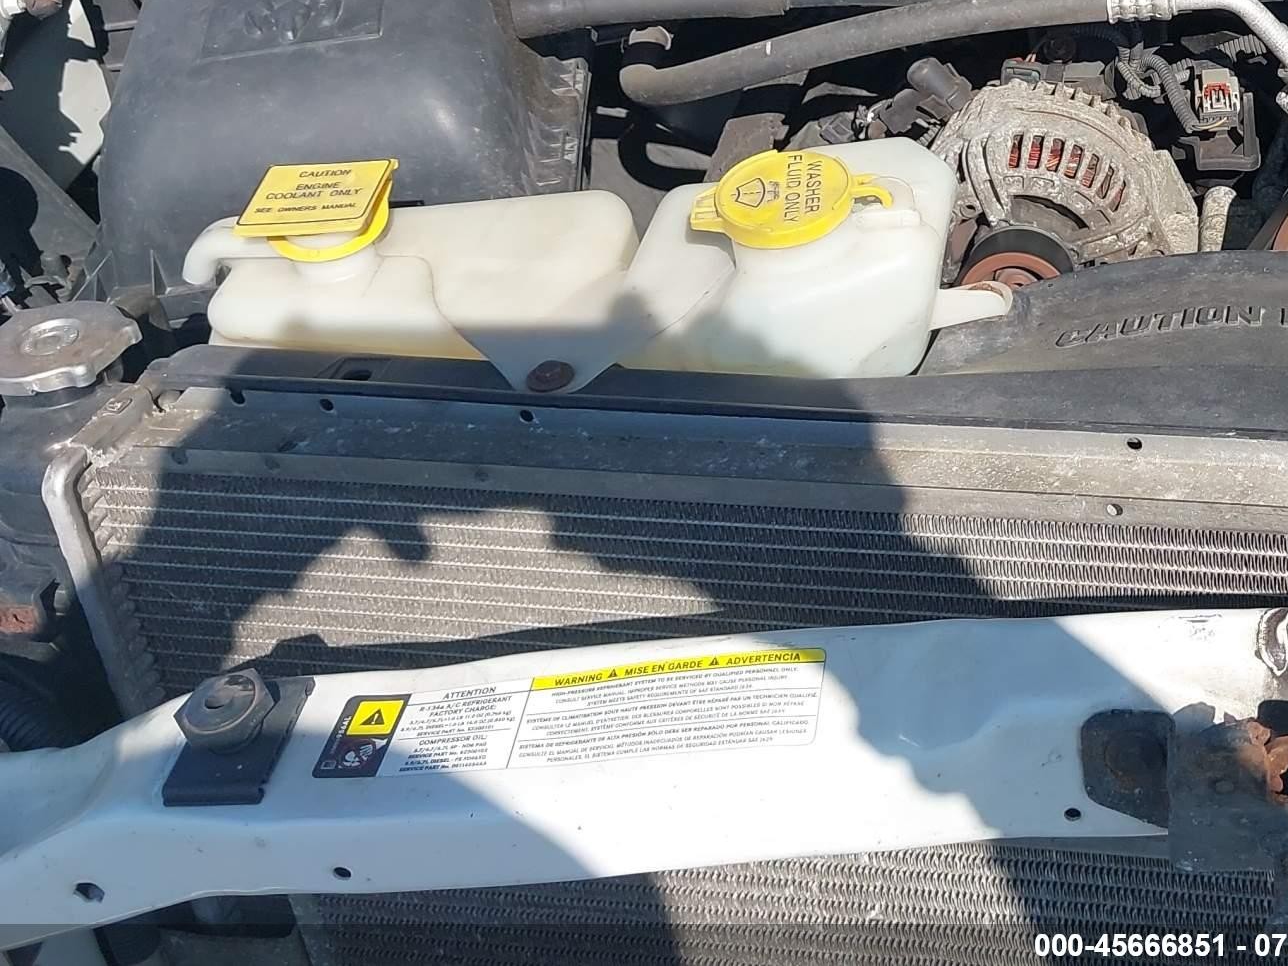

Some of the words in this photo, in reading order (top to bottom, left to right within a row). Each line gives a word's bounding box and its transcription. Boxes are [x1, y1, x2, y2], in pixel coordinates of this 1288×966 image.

[299, 169, 352, 178] CAUTION
[787, 155, 803, 188] FLUID
[295, 182, 342, 191] ENGINE
[804, 160, 823, 215] WASHER
[265, 191, 323, 200] COOLANT
[329, 188, 363, 197] ONLY
[277, 205, 317, 213] OWNERS
[321, 202, 358, 210] MANUAL
[783, 193, 801, 223] ONLY
[1055, 305, 1266, 348] CAUTION
[554, 672, 603, 686] WARNING
[624, 665, 650, 676] MISE
[652, 663, 666, 673] EN
[667, 659, 704, 671] GARDE
[726, 652, 801, 666] ADVERTENCIA
[442, 686, 497, 700] ATTENTION
[446, 701, 461, 709] A/C
[461, 695, 512, 707] REFRIGERANT
[429, 708, 463, 717] FACTORY
[418, 734, 471, 746] COMPRESSOR
